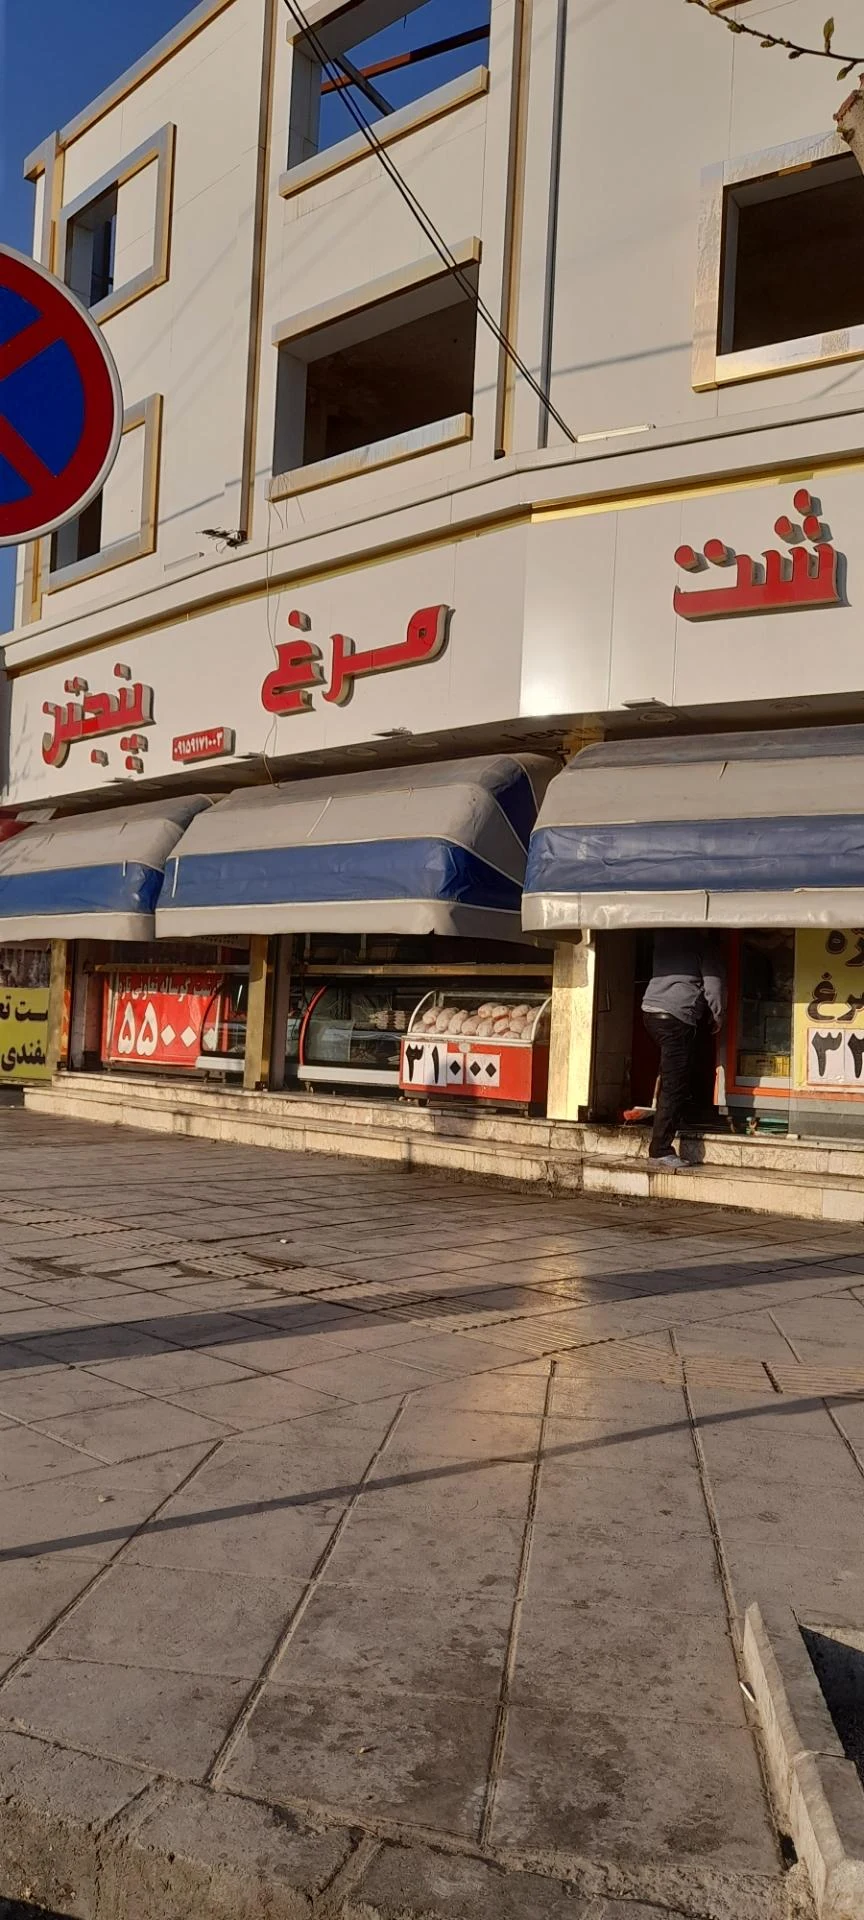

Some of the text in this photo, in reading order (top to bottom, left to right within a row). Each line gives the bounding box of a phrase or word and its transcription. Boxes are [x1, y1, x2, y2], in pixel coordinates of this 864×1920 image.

[261, 604, 449, 715] مرغ
[42, 663, 153, 771] پنجتن
[406, 1044, 498, 1085] ۳۱۰۰۰
